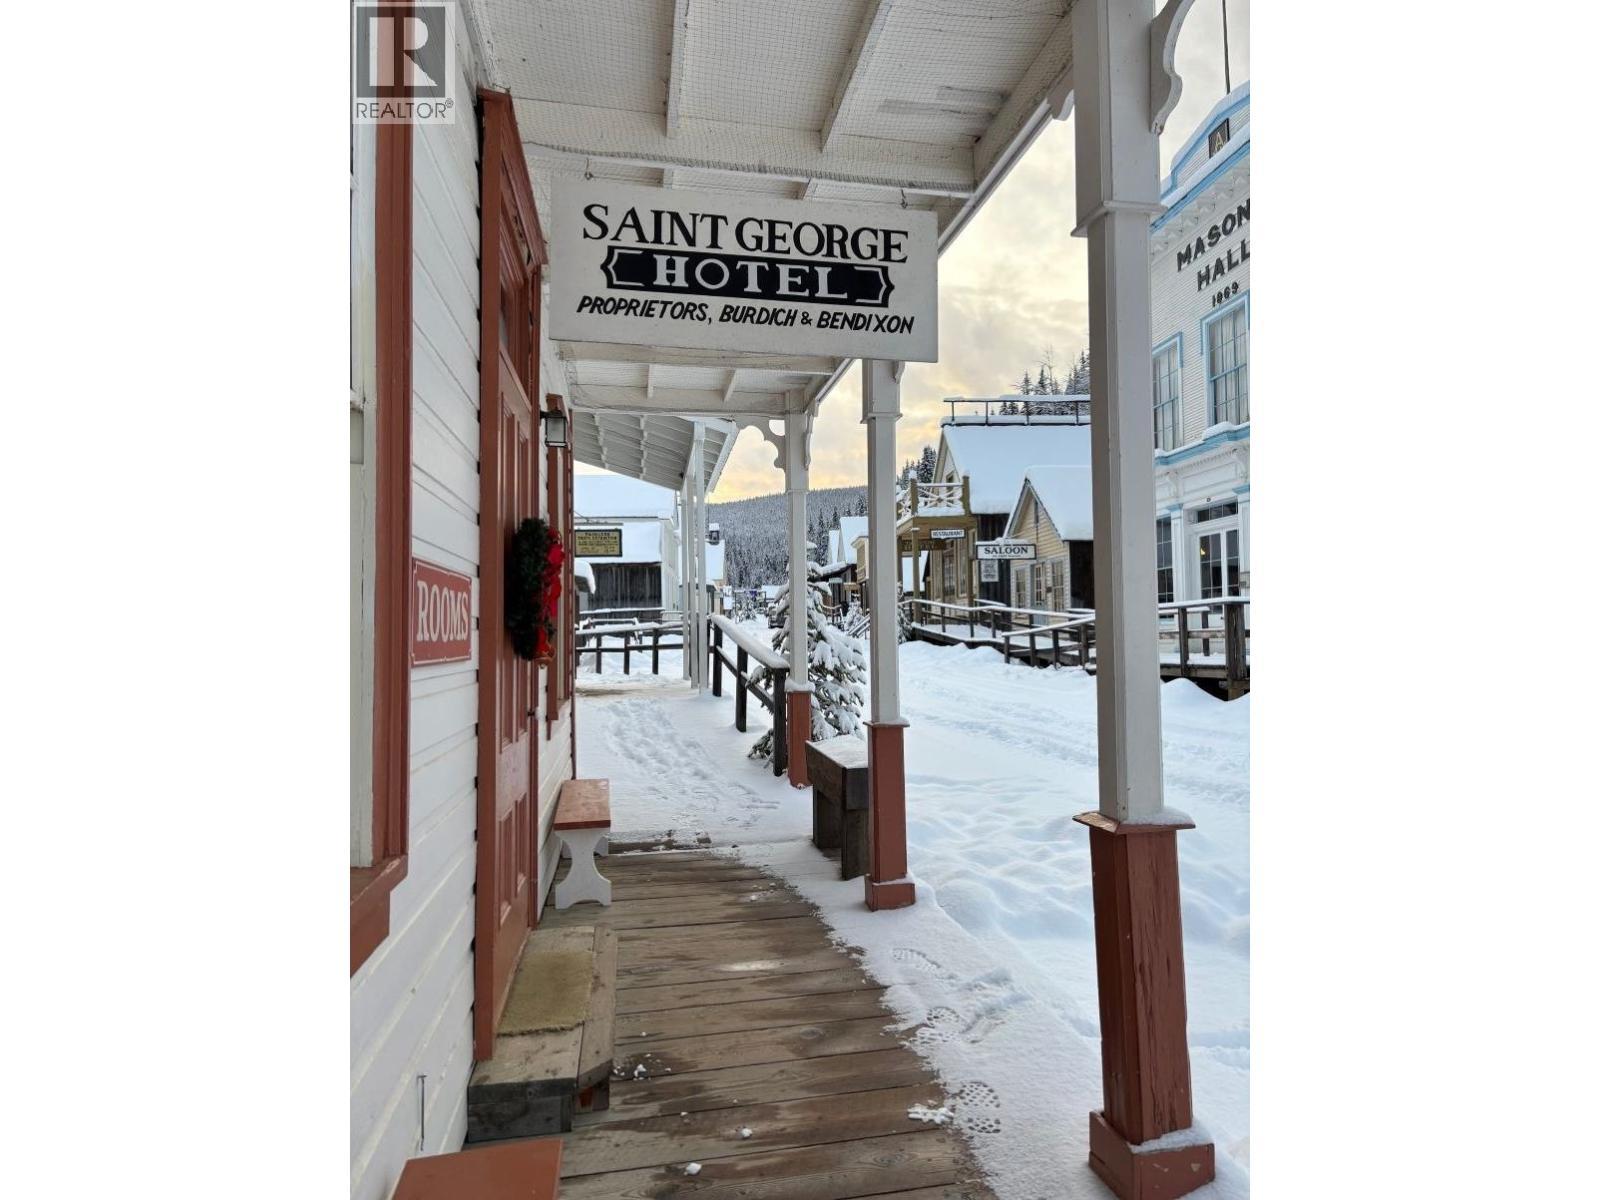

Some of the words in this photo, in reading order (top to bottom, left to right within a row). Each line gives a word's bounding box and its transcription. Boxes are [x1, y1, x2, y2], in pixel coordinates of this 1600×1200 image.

[582, 203, 728, 249] SAINT
[734, 216, 908, 264] GEORGE
[652, 253, 848, 300] HOTEL
[1197, 238, 1250, 292] HALL
[576, 295, 713, 325] PROPRIETORS,
[718, 303, 797, 328] BURDICH
[800, 311, 812, 326] &
[816, 313, 915, 335] BENDIXON
[984, 546, 1028, 555] SALOON
[416, 580, 469, 642] ROOMS
